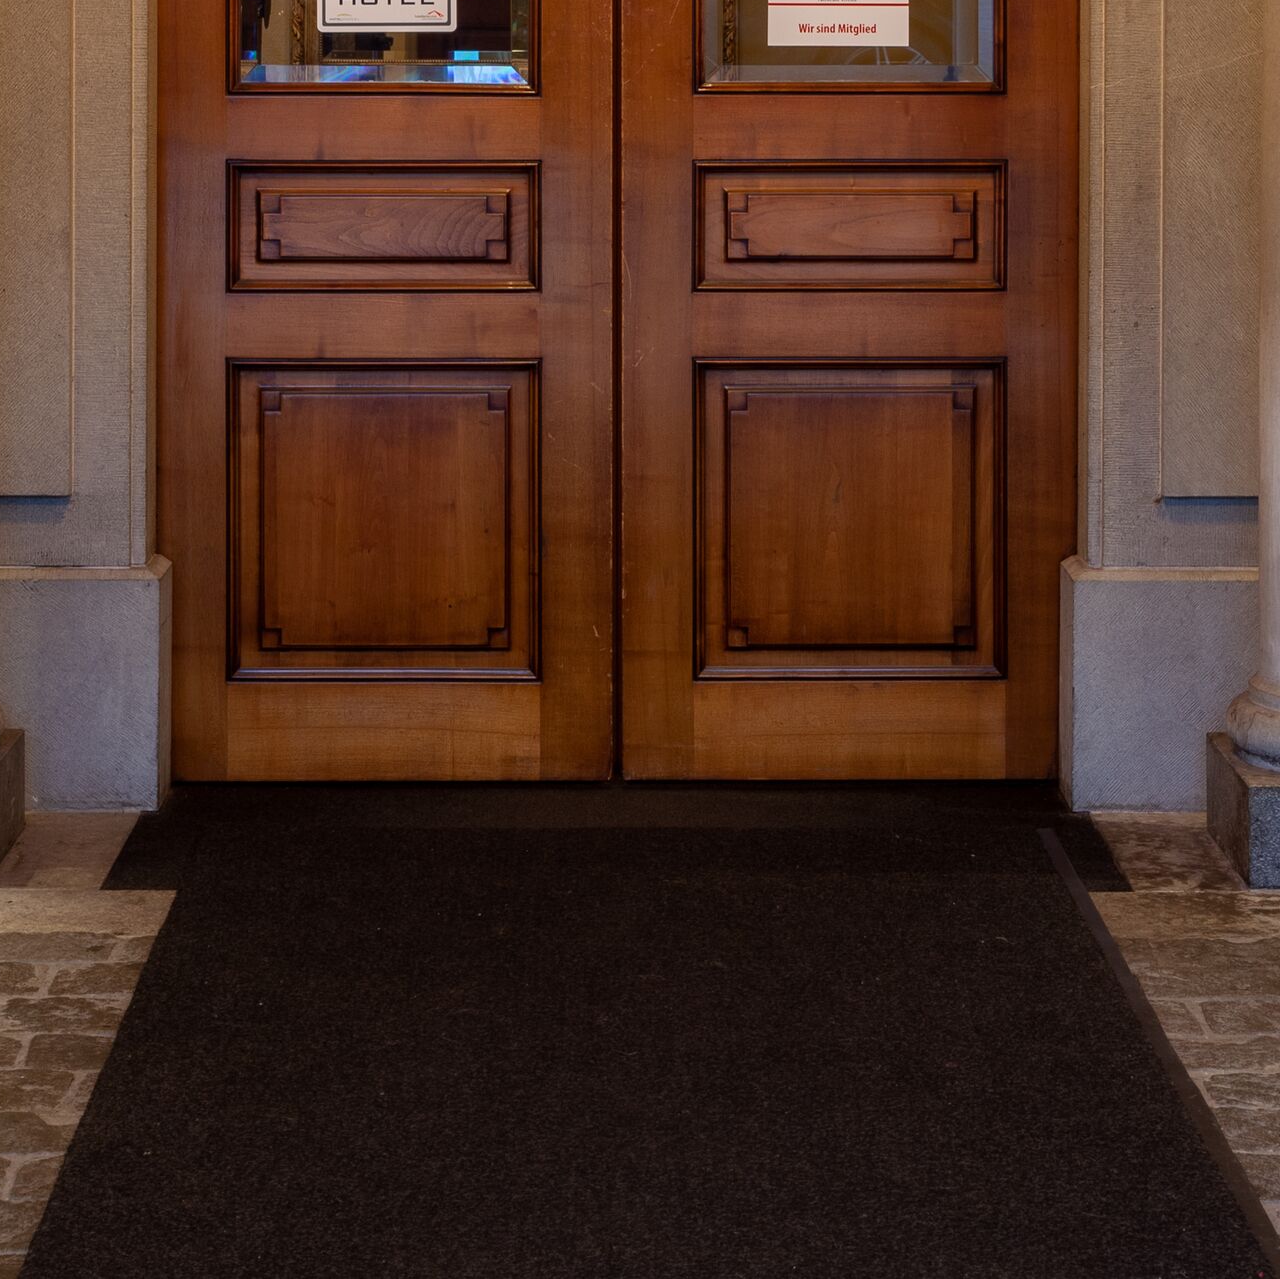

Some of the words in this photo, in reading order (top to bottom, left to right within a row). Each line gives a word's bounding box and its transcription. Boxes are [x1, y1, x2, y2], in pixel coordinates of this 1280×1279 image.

[799, 24, 814, 33] Wir
[816, 24, 835, 33] sind
[838, 24, 877, 36] Mitglied
